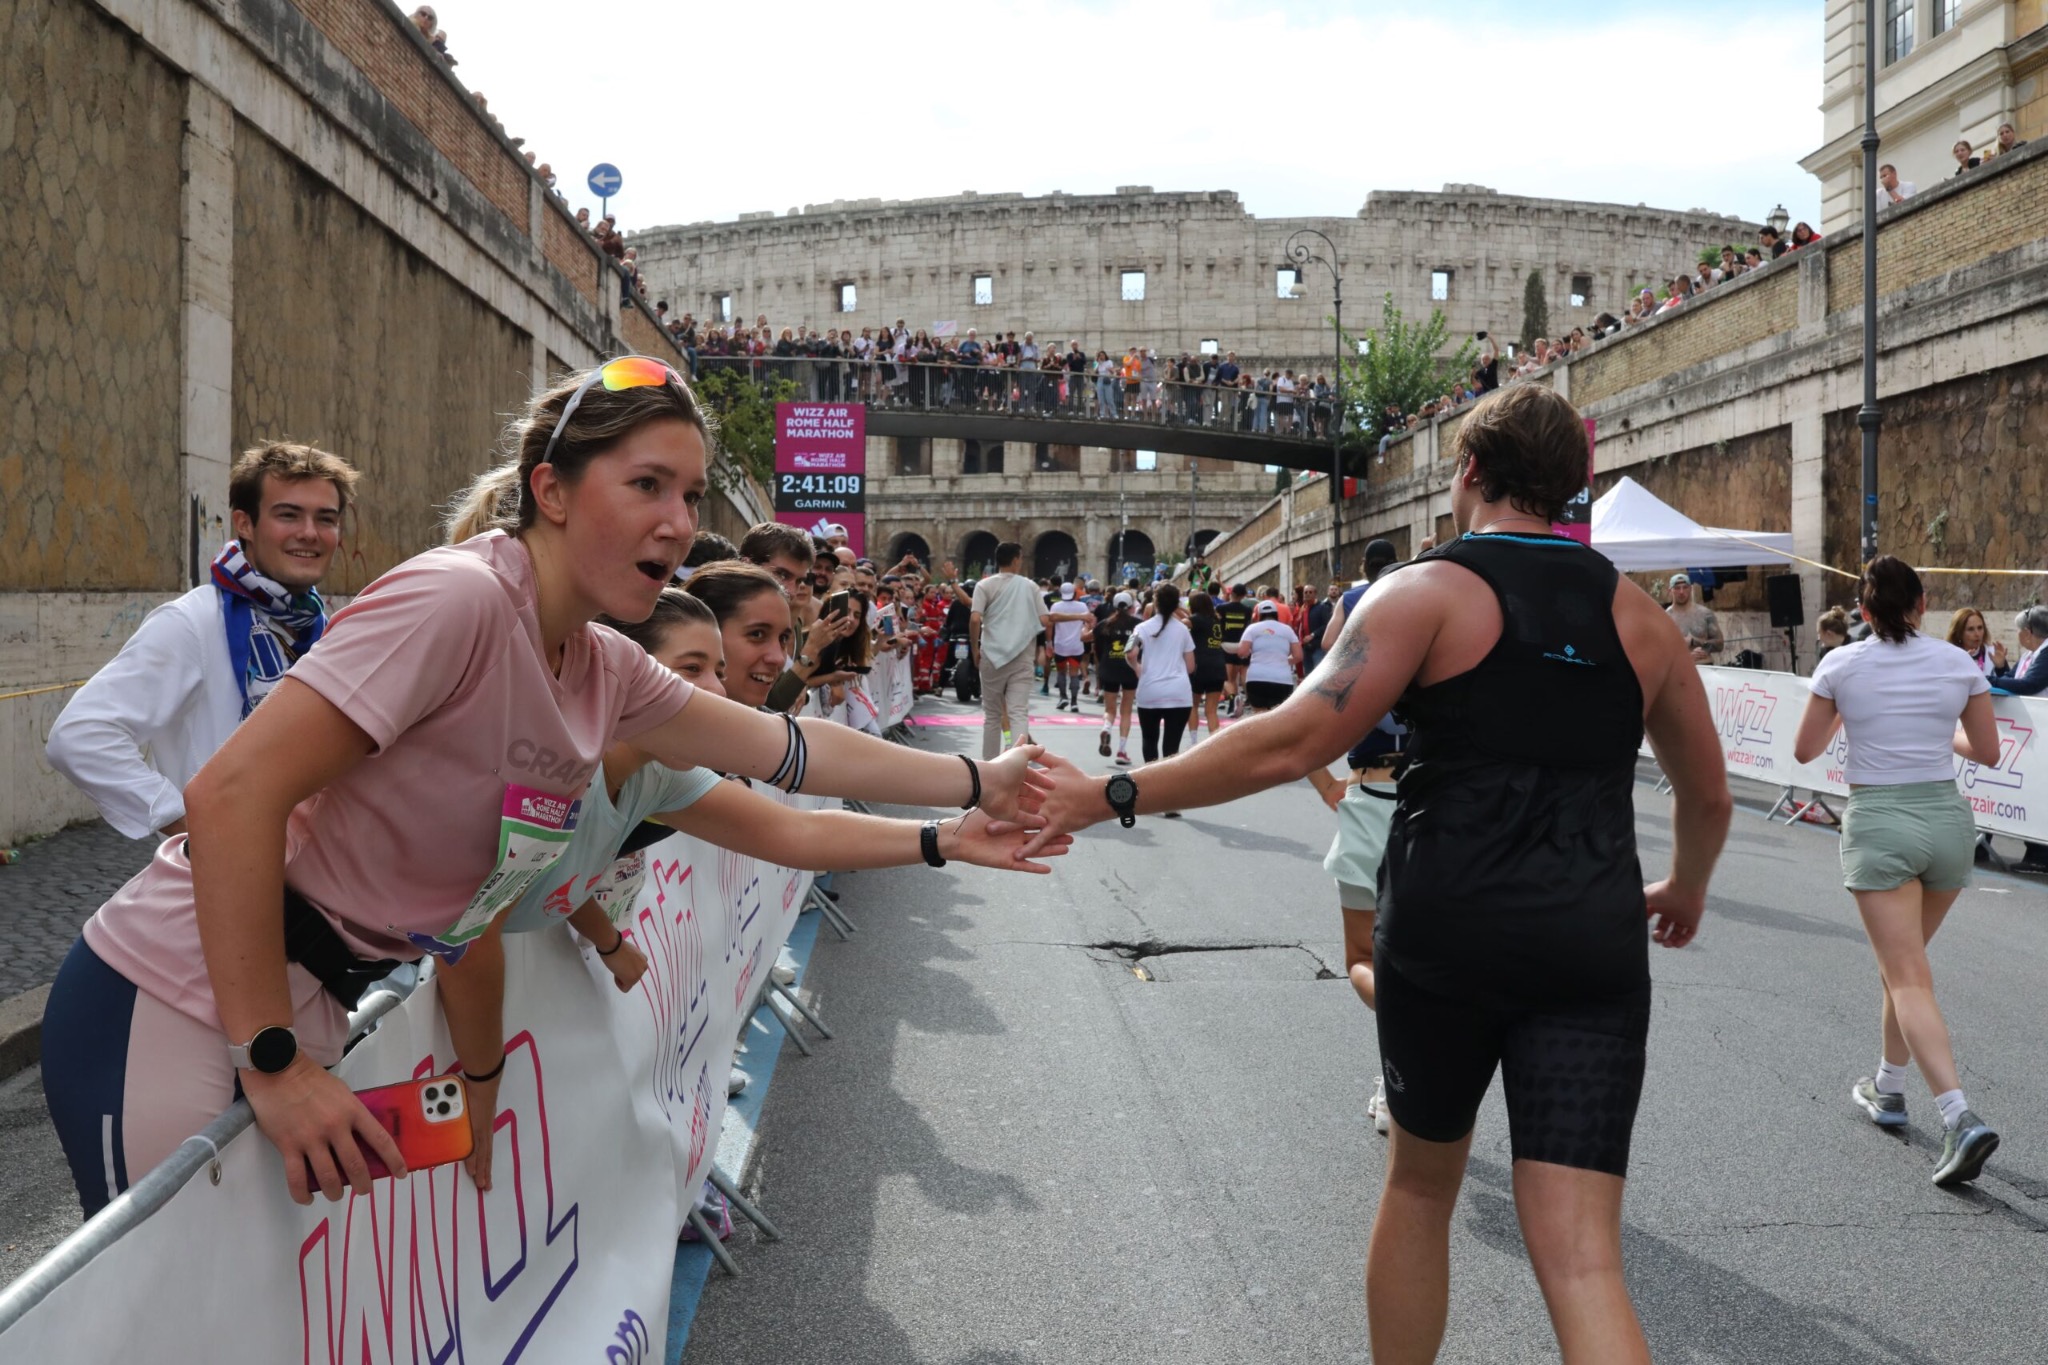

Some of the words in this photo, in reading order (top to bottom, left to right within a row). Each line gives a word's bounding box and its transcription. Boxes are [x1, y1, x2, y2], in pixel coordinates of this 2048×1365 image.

[793, 407, 825, 417] WIZZ
[827, 408, 848, 417] AIR
[786, 417, 821, 427] ROME
[823, 418, 855, 428] HALF
[786, 428, 854, 439] MARATHON
[782, 474, 860, 494] 2:41:09
[1727, 747, 1774, 770] wizzair.com
